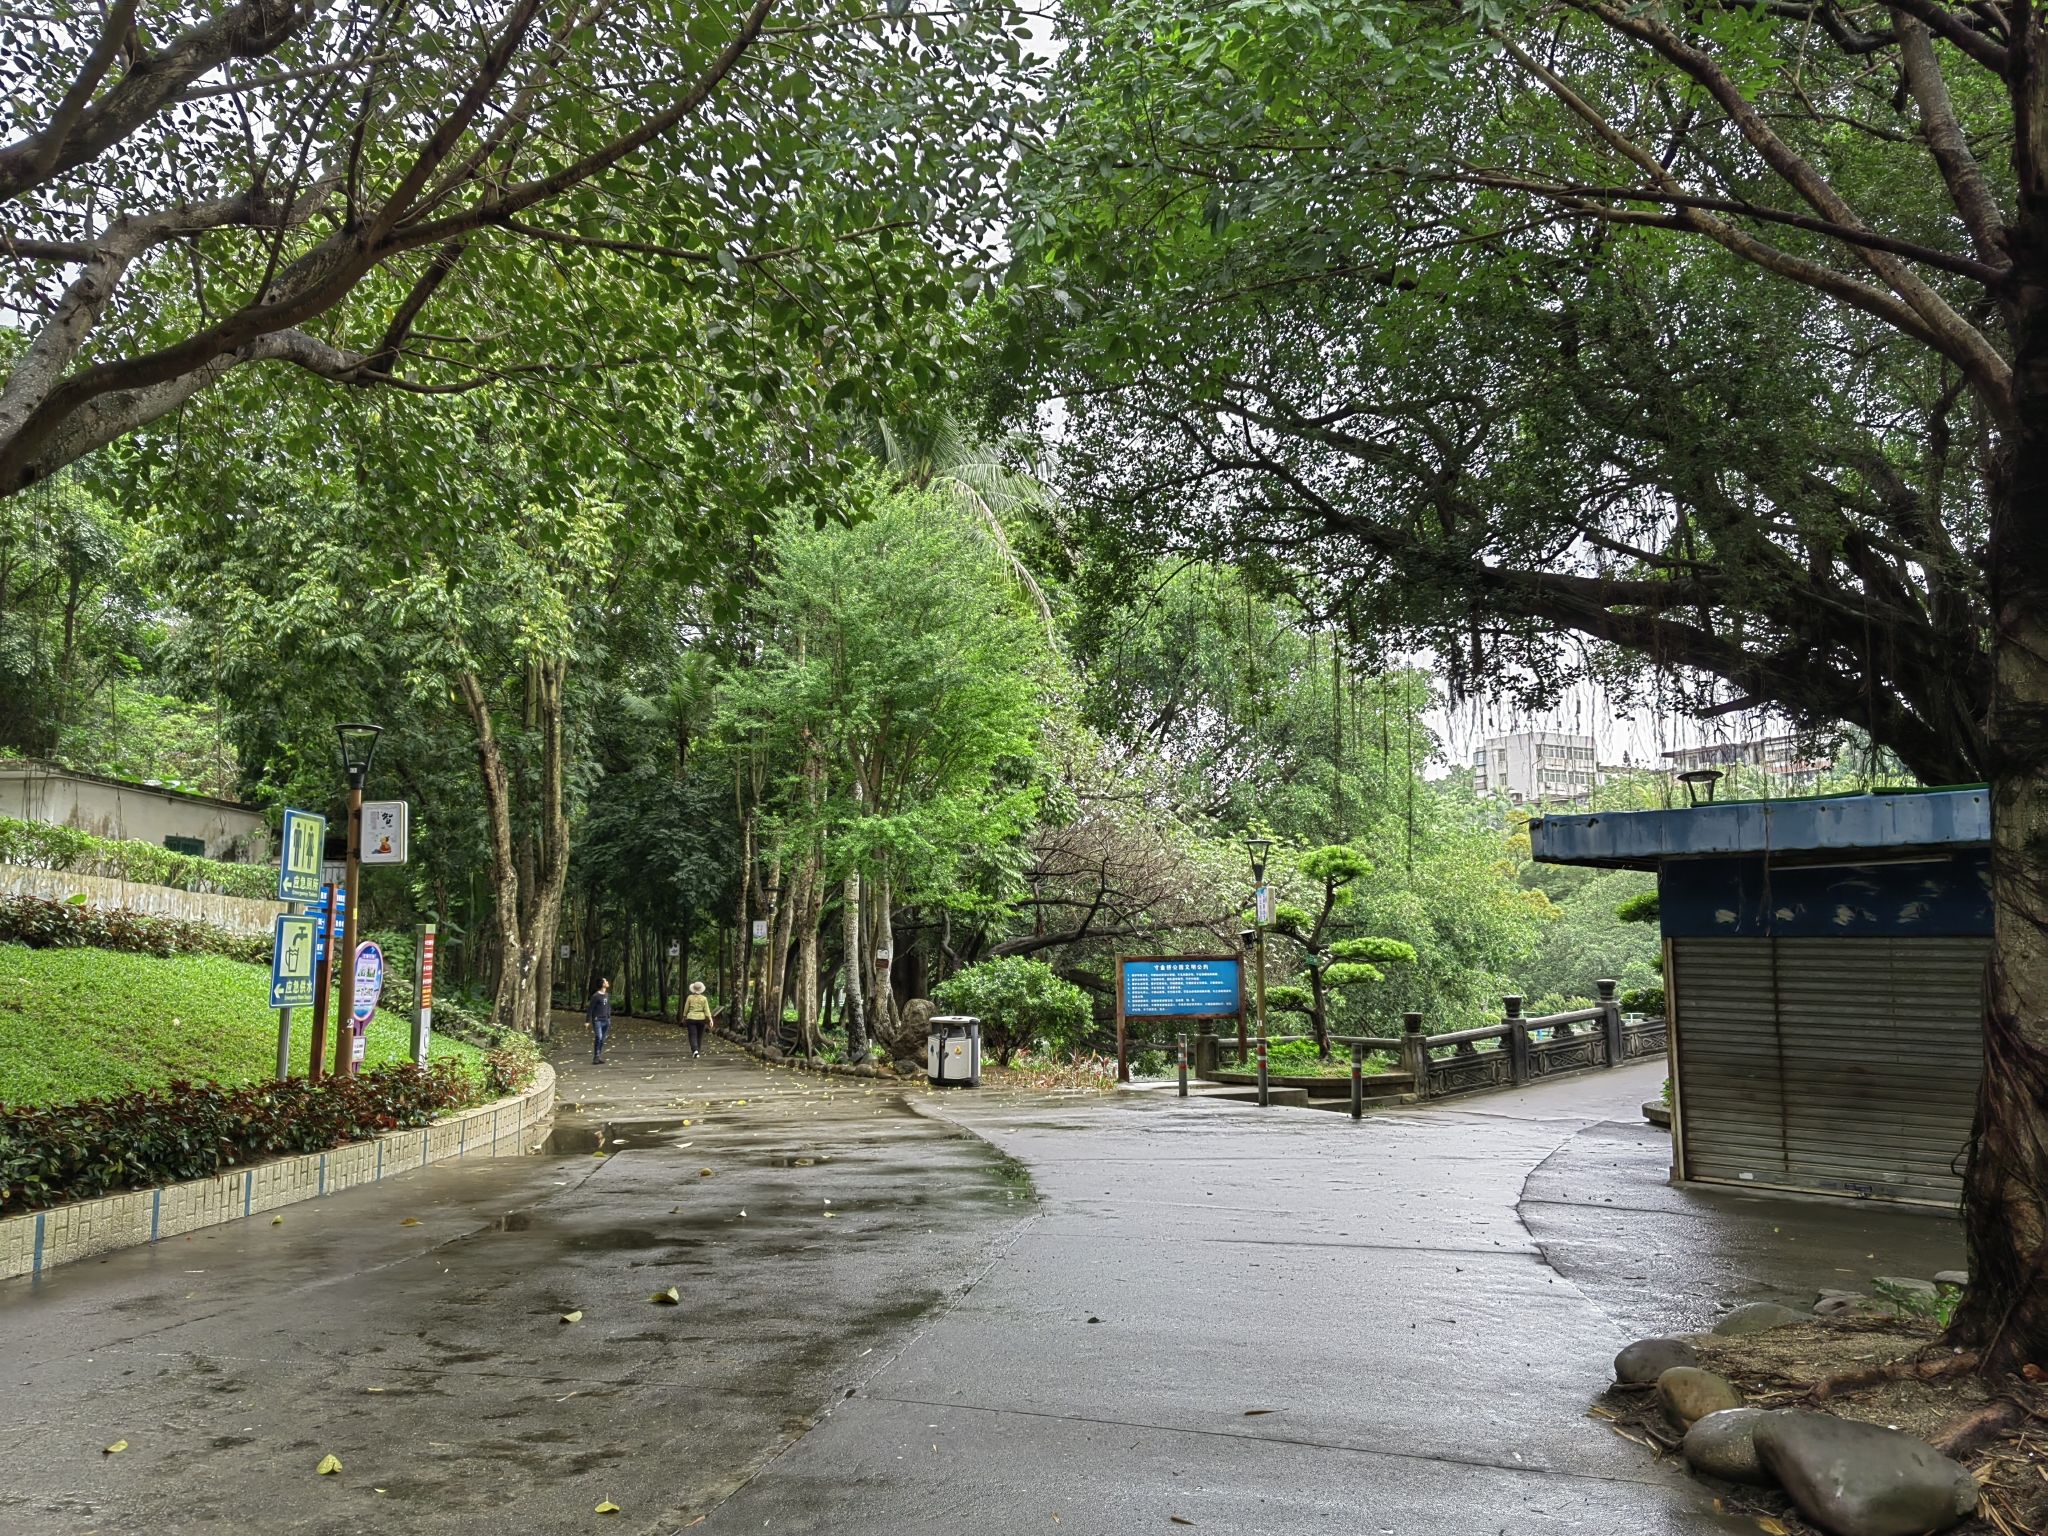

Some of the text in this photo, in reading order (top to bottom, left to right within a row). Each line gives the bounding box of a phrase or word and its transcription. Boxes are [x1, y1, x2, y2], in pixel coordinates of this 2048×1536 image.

[293, 875, 319, 891] 应急厕所
[285, 980, 312, 994] 应急供水
